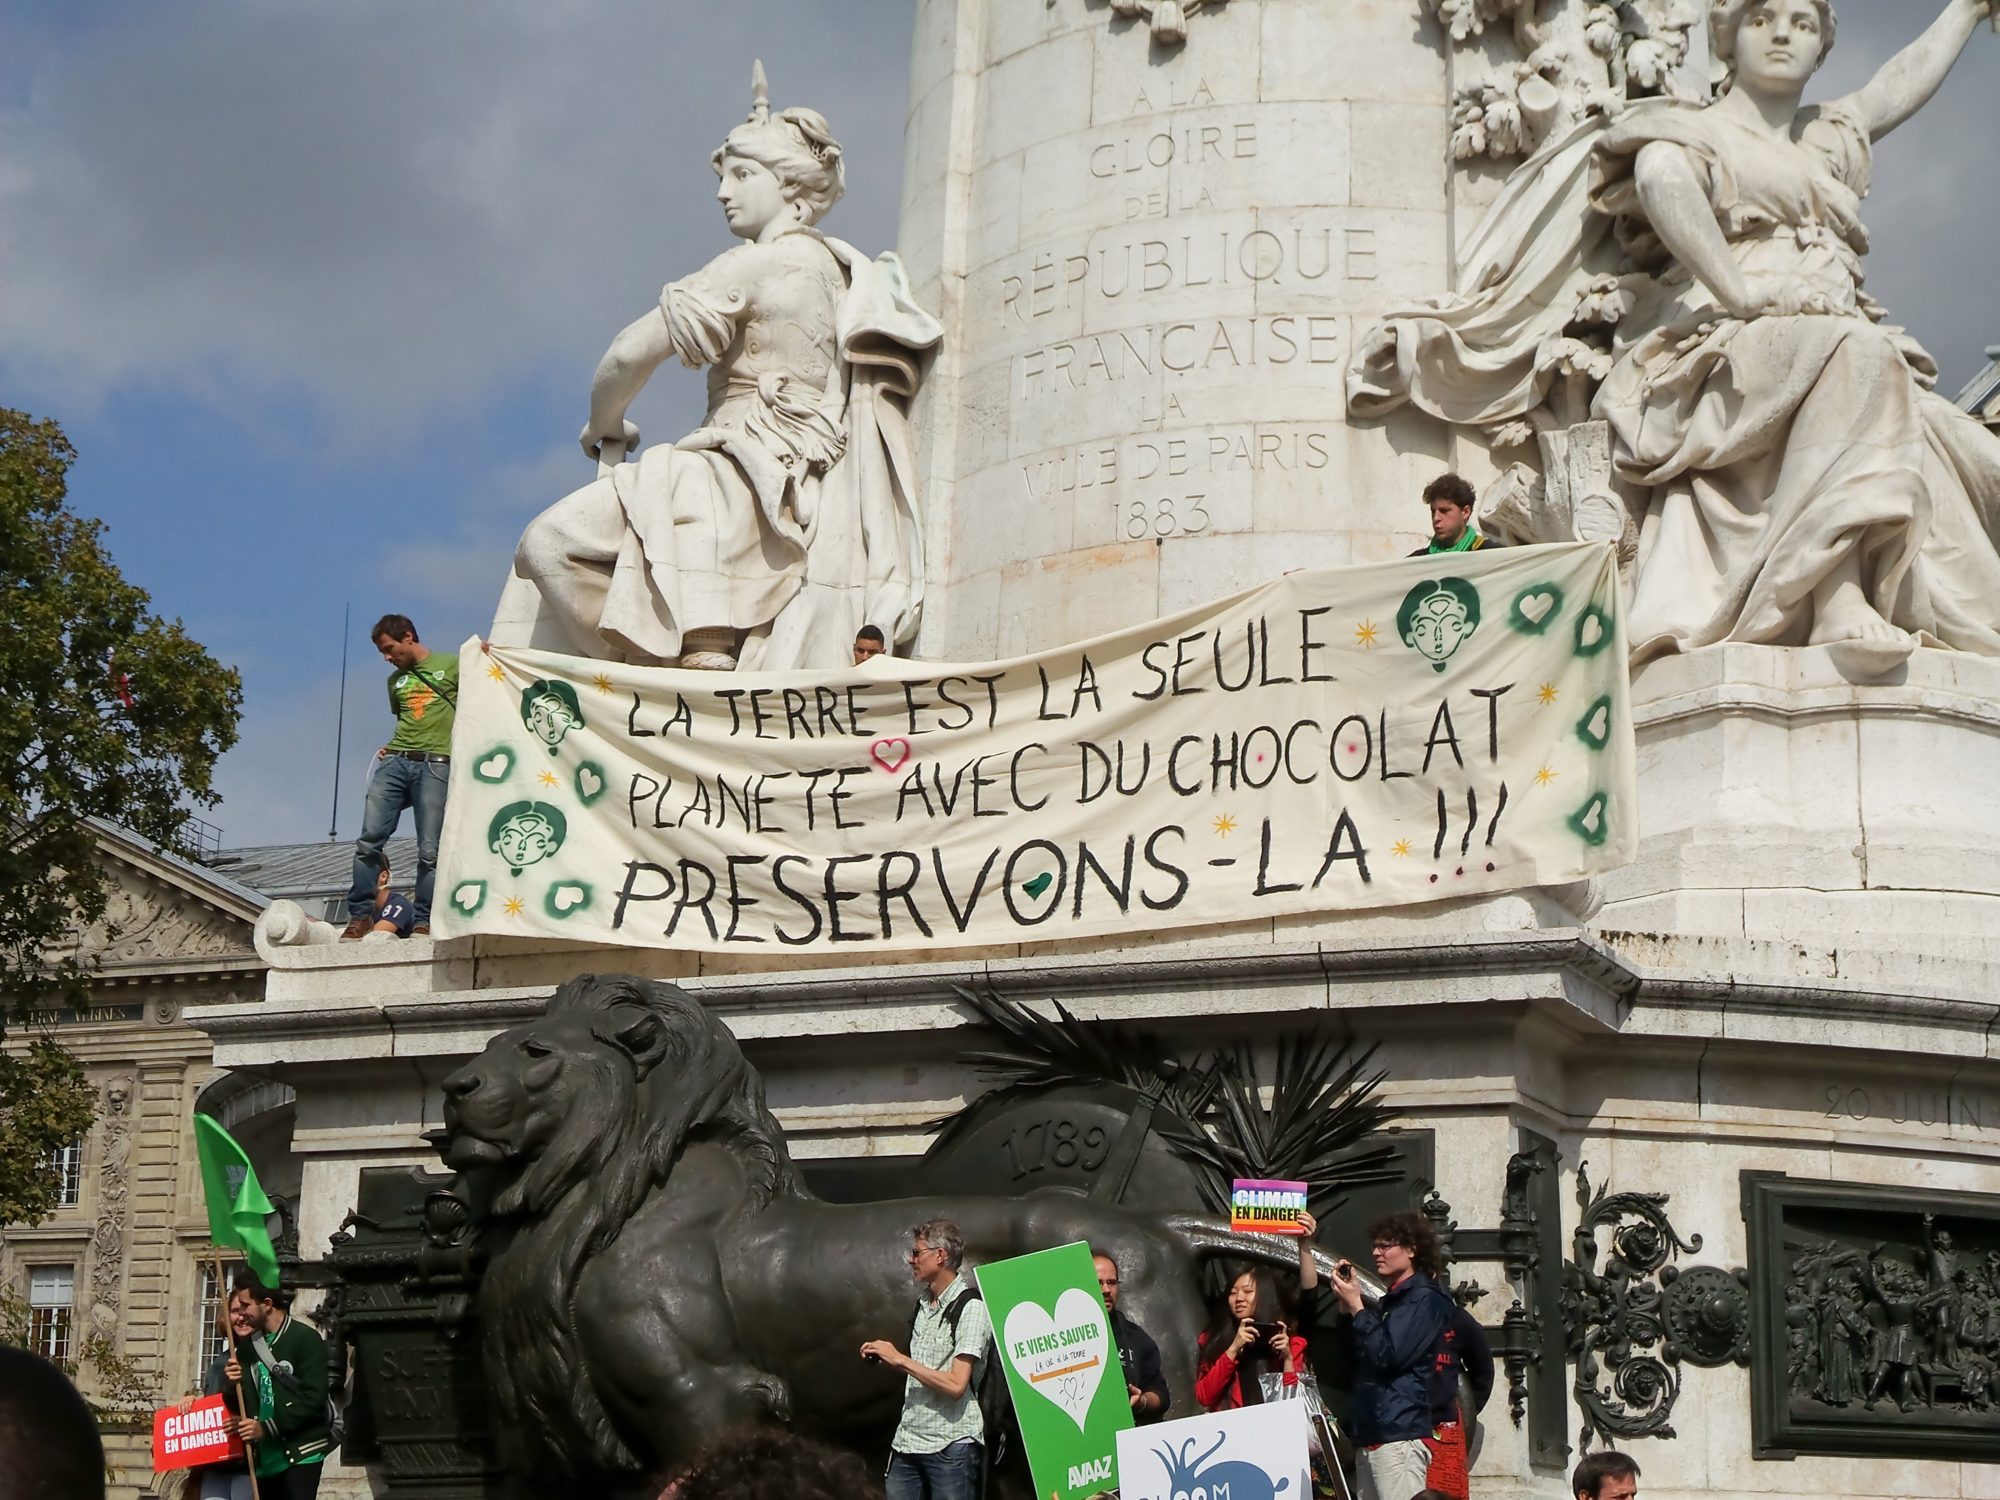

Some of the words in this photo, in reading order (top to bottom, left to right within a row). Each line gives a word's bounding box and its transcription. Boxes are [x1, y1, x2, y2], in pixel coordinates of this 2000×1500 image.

[1131, 87, 1153, 113] A
[1169, 77, 1216, 107] LA
[1090, 123, 1257, 178] GLOIRE
[1125, 193, 1162, 219] DE
[1178, 186, 1215, 211] LA
[1001, 228, 1378, 328] RÉPUBLIQUE
[1022, 316, 1339, 400] FRANÇAISE
[1142, 393, 1186, 423] LA
[1023, 447, 1118, 496] VILLE
[1135, 439, 1190, 480] DE
[1208, 432, 1329, 473] PARIS
[1113, 493, 1210, 543] 1883
[628, 691, 692, 738] LA
[713, 684, 876, 741] TERRE
[900, 671, 1007, 737] EST
[1038, 653, 1102, 721] LA
[1132, 604, 1339, 702] SEULE
[628, 765, 874, 834] PLANETE
[896, 741, 1051, 822] AVEC
[1076, 739, 1151, 805] DU
[1167, 681, 1517, 797] CHOCOLAT
[1427, 780, 1509, 884] !!!
[1823, 1085, 1871, 1121] 20
[1891, 1091, 1983, 1132] JUIN
[1000, 1118, 1112, 1182] 1789
[1235, 1189, 1303, 1208] CLIMAT
[1236, 1206, 1250, 1219] EN
[1014, 1341, 1027, 1359] JE
[1026, 1333, 1059, 1356] VIENS
[1059, 1322, 1099, 1347] SAUVER
[1035, 1361, 1044, 1372] LA
[164, 1406, 225, 1437] CLIMAT
[165, 1438, 179, 1454] EN
[1068, 1454, 1113, 1490] AVAAZ
